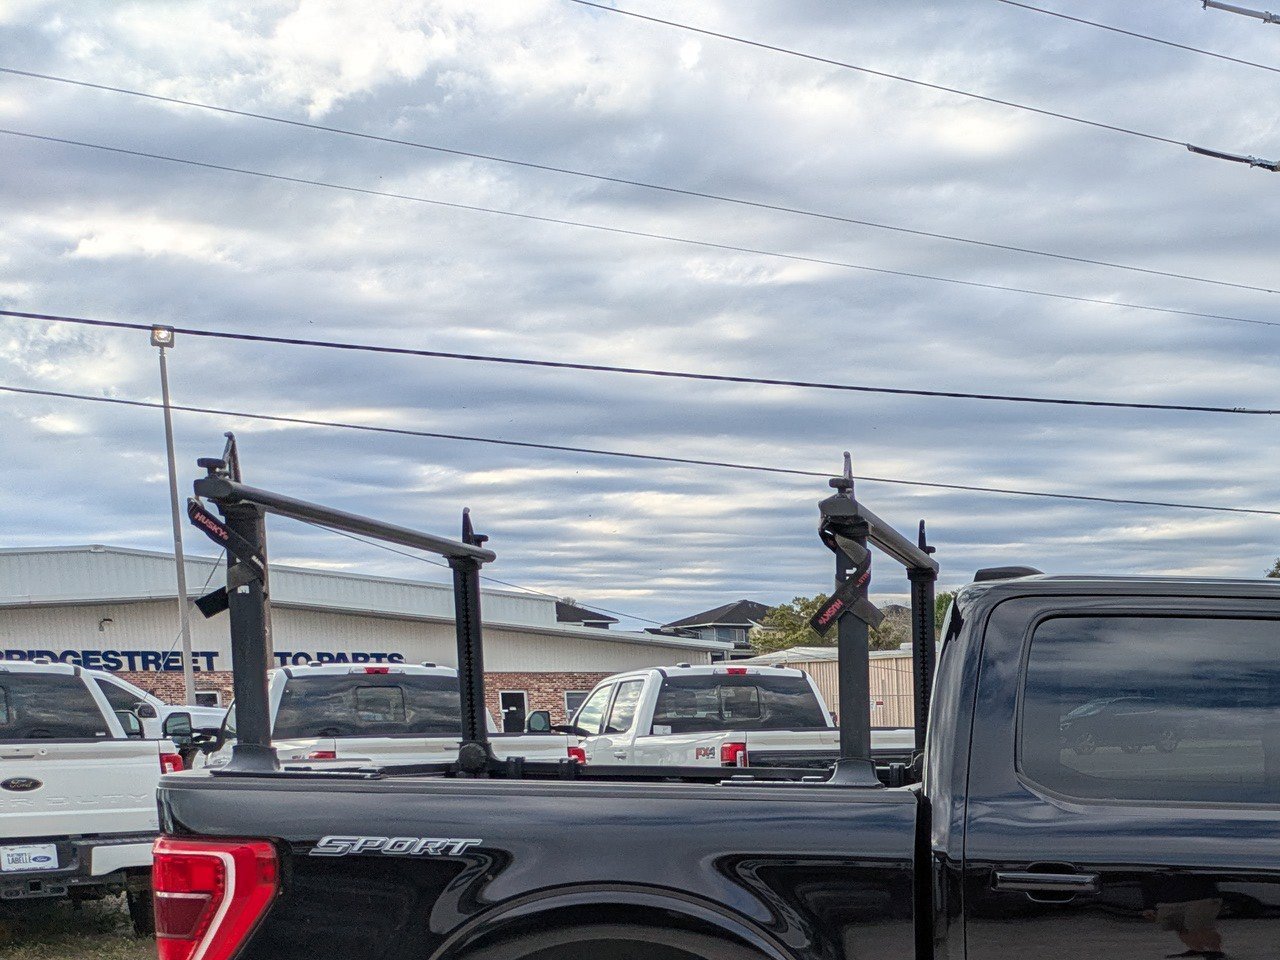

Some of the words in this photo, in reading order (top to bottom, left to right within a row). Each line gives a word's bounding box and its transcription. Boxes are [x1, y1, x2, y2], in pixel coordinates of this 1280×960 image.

[194, 512, 226, 540] HUSKY
[820, 598, 843, 625] HUSKY
[0, 650, 219, 672] RIDGESTREET
[309, 835, 483, 857] SPORT
